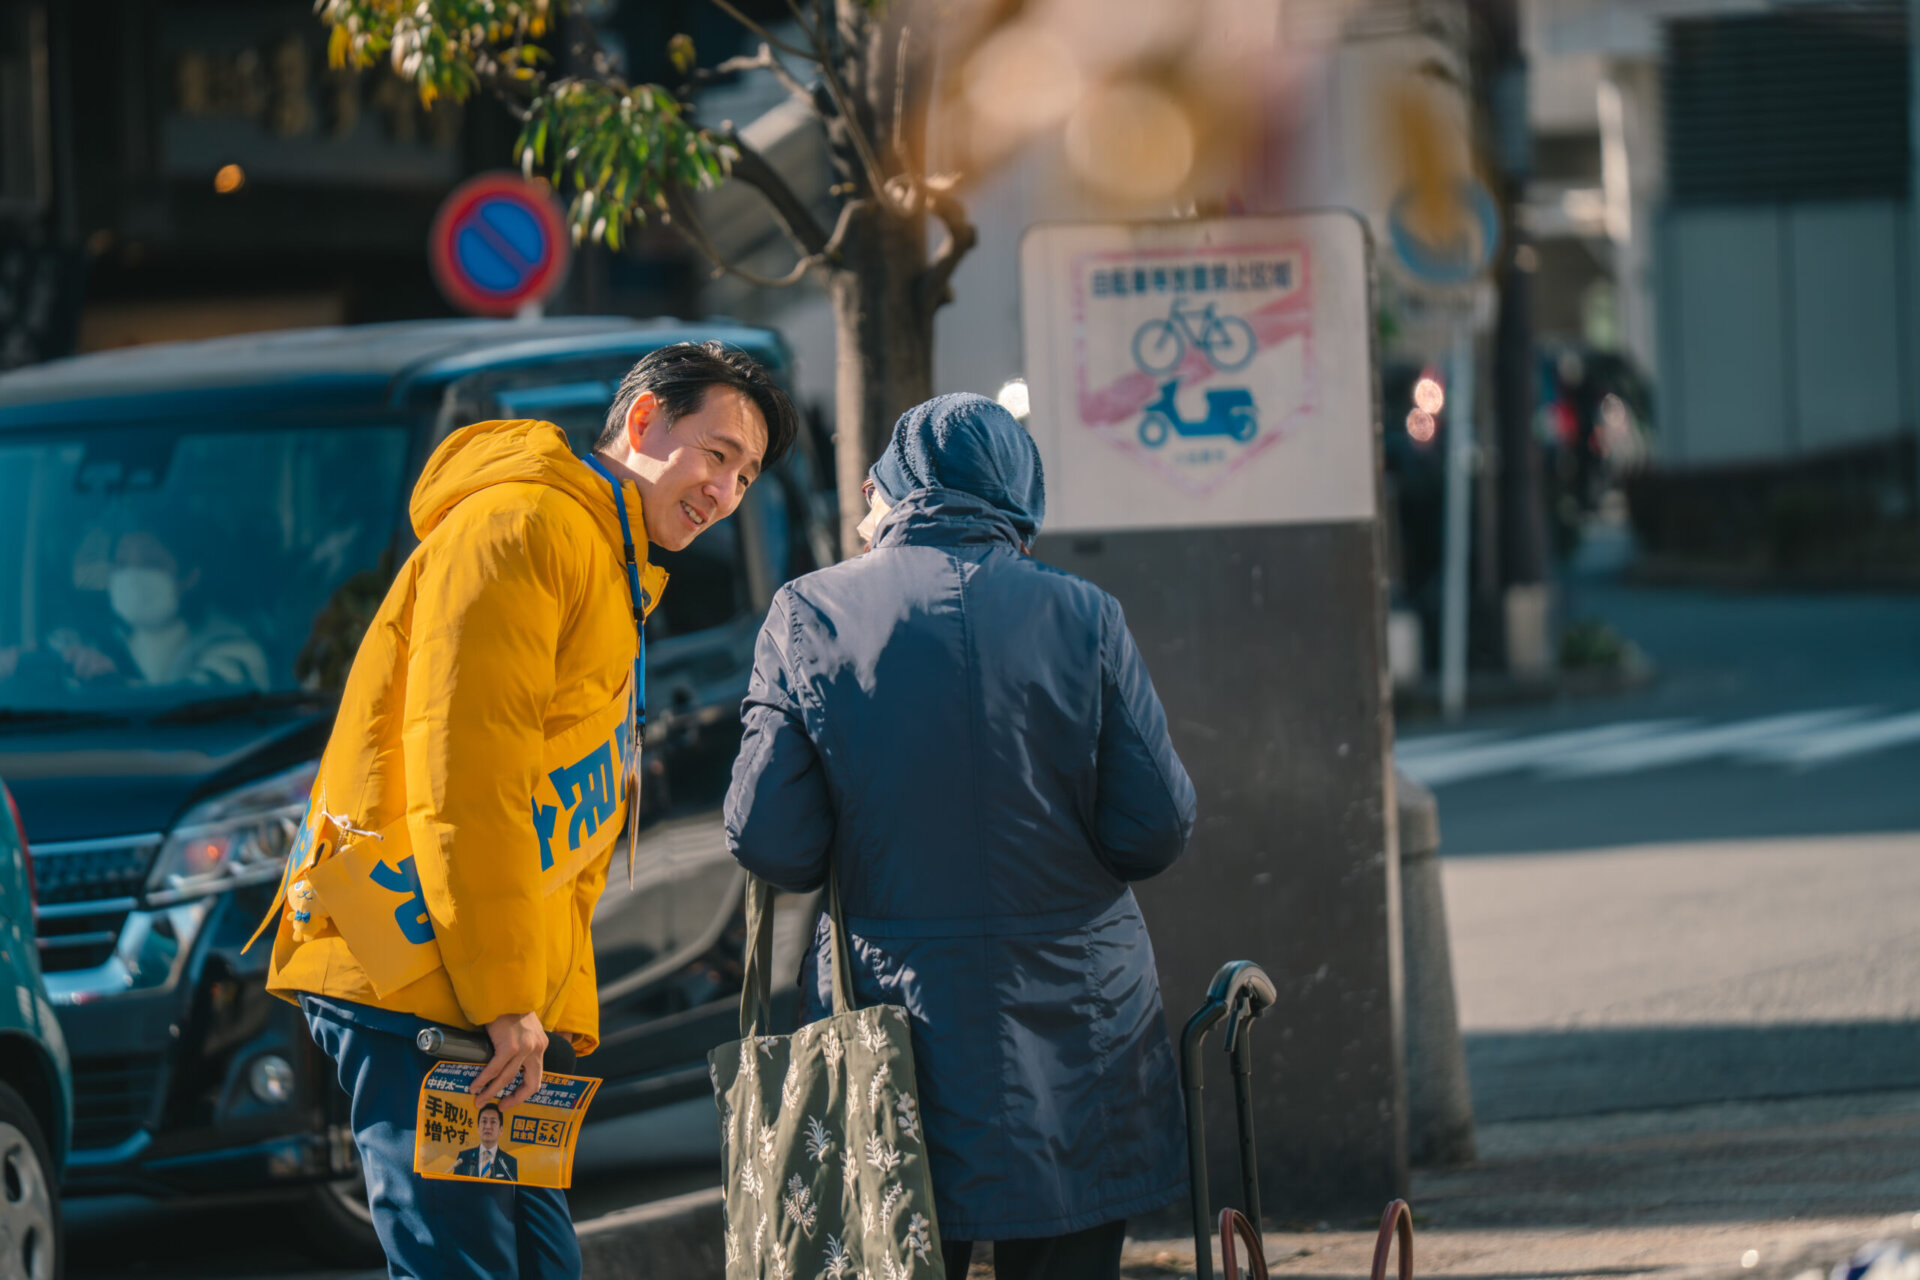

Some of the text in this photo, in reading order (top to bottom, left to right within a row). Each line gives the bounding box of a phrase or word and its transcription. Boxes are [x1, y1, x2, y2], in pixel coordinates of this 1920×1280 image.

[425, 1095, 473, 1128] 手取りを
[540, 1122, 559, 1133] こく
[538, 1132, 558, 1143] みん
